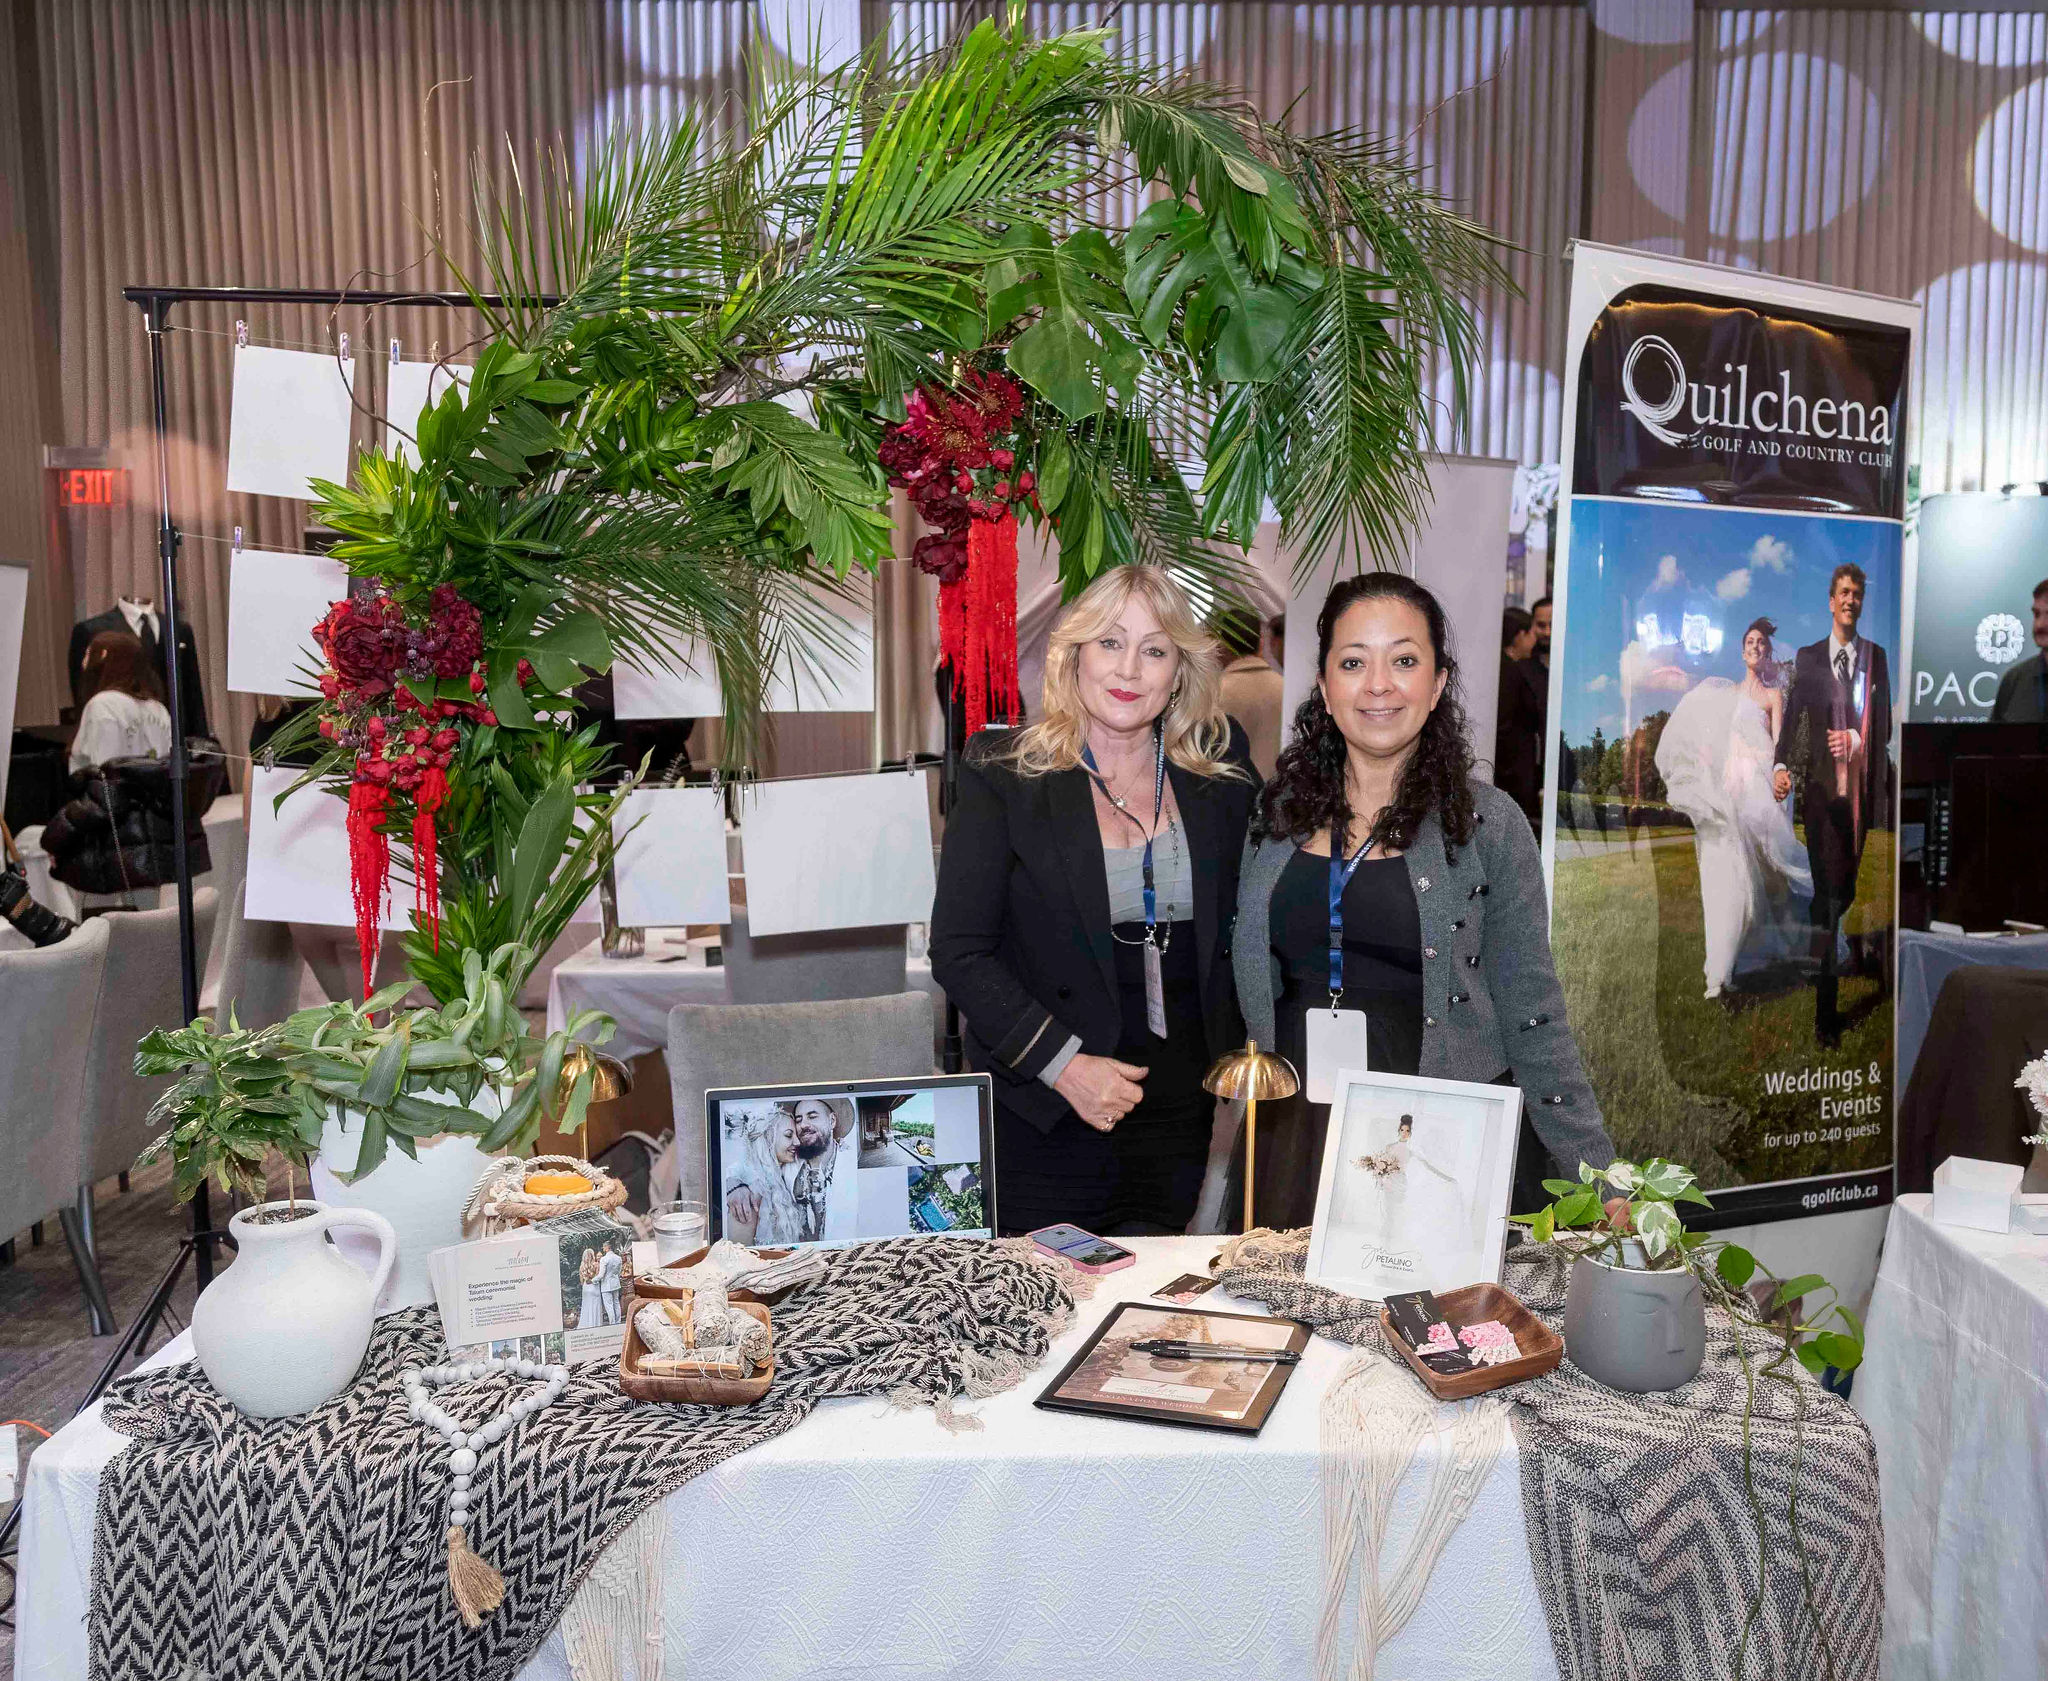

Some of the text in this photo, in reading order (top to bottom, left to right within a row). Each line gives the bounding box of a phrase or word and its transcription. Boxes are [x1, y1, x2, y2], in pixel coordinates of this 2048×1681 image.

[1620, 335, 1893, 447] Quilchena
[1702, 435, 1893, 468] GOLF AND COUNTRY CLUB
[70, 469, 112, 504] EXIT
[1914, 671, 1999, 708] PAC
[1765, 1061, 1882, 1096] Weddings &
[1820, 1092, 1882, 1120] Events
[1764, 1121, 1882, 1149] for up to 240 guests
[1801, 1184, 1879, 1209] qgolfclub.ca
[468, 1281, 499, 1290] Experience
